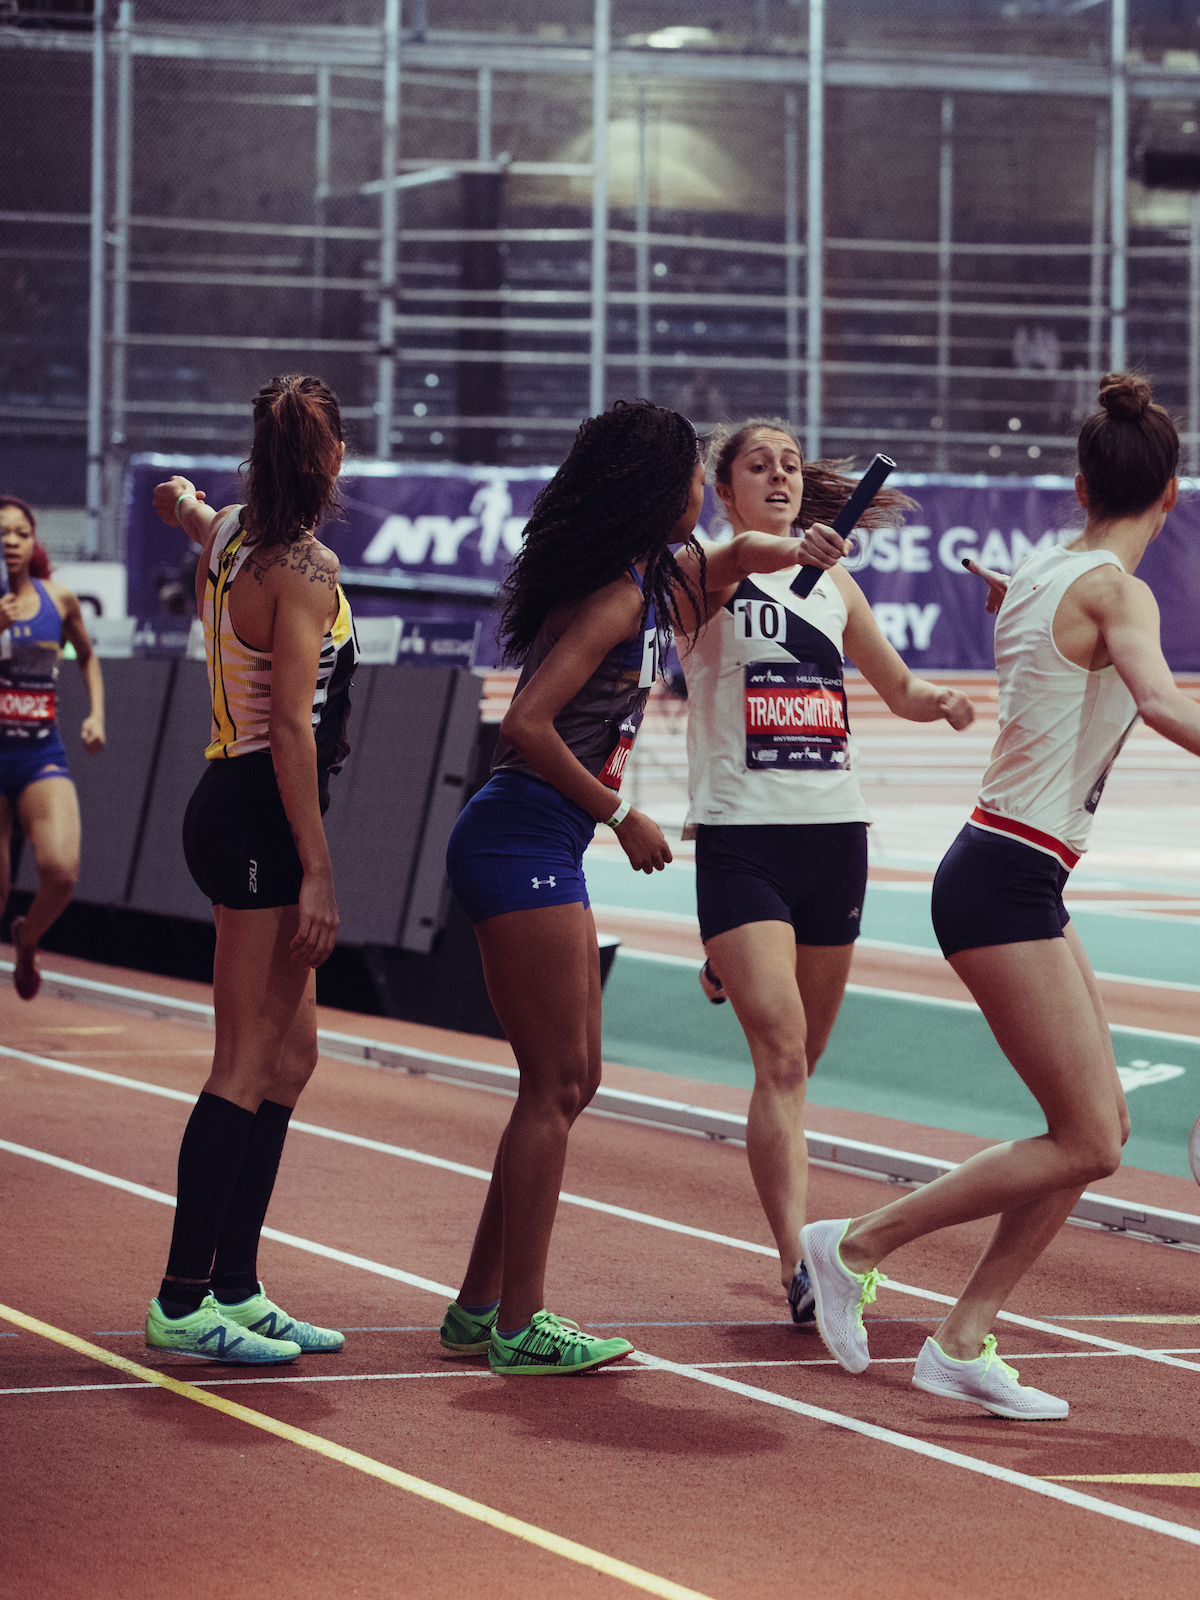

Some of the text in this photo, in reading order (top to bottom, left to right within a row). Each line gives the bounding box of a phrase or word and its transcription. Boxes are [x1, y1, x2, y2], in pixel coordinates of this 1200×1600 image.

[738, 601, 779, 639] 10
[747, 696, 845, 729] TRACKSMITH AC
[249, 858, 258, 894] 2XU
